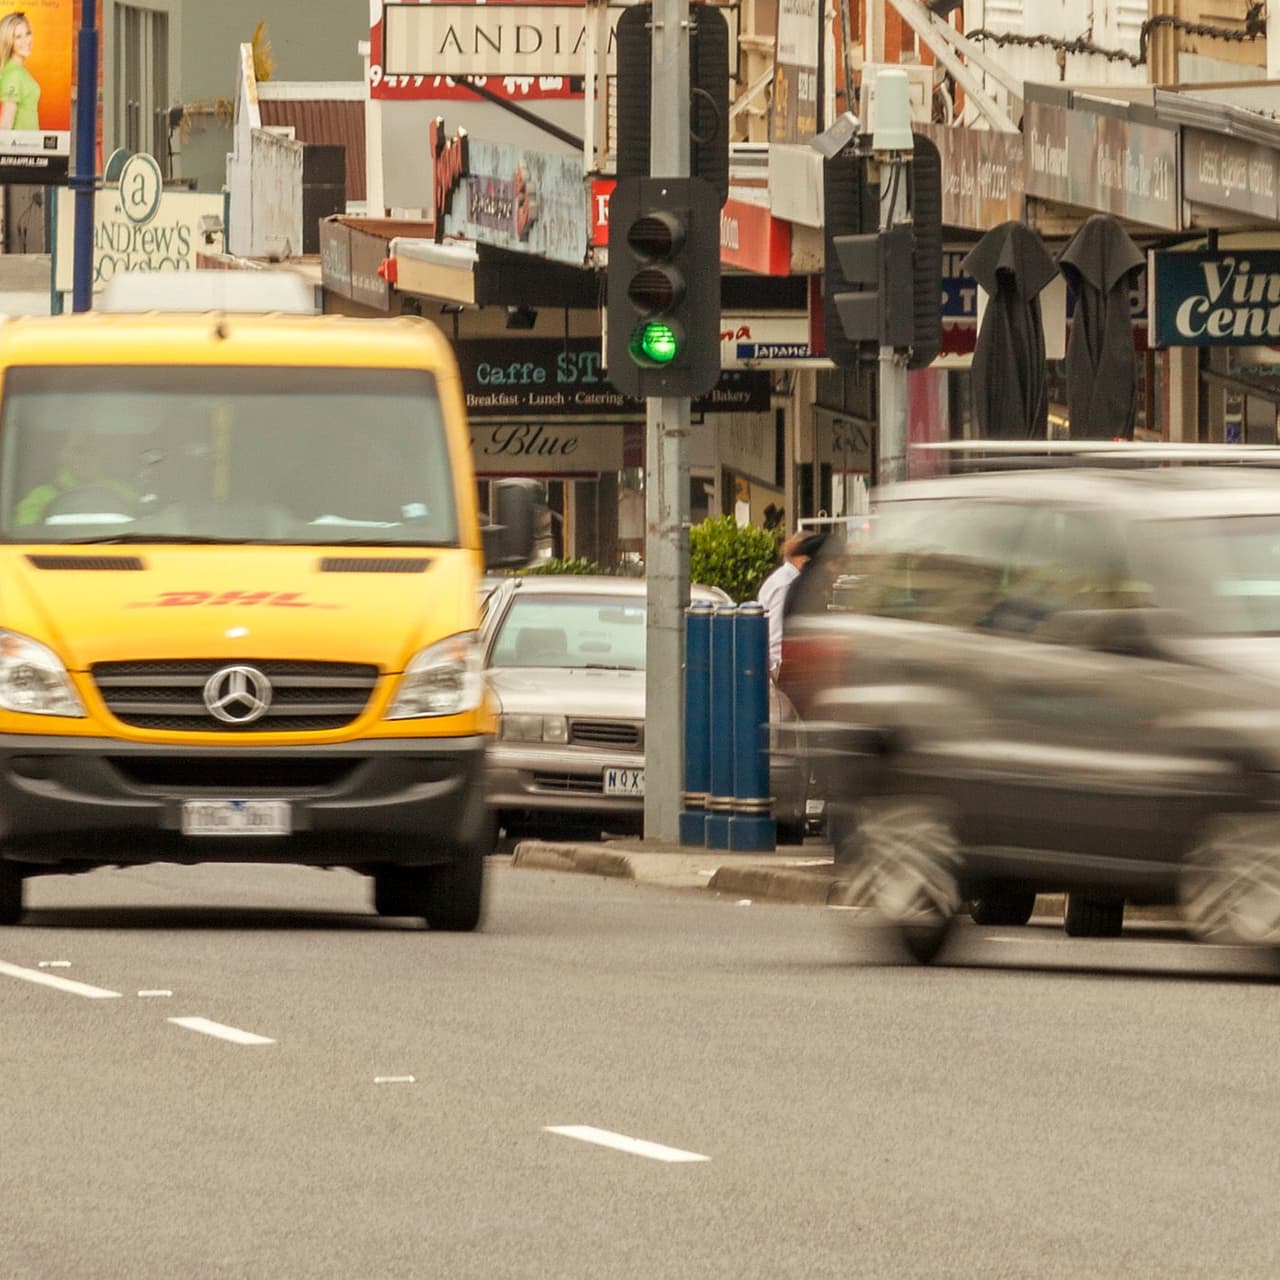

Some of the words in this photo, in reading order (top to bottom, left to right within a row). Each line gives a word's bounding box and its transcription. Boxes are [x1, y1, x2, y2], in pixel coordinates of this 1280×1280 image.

[131, 172, 147, 206] a
[476, 361, 547, 386] Caffe
[466, 393, 519, 408] Breakfast
[528, 393, 565, 407] Lunch
[575, 392, 624, 408] Catering
[712, 391, 752, 406] Bakery
[484, 424, 578, 457] Blue
[156, 590, 313, 608] DHL
